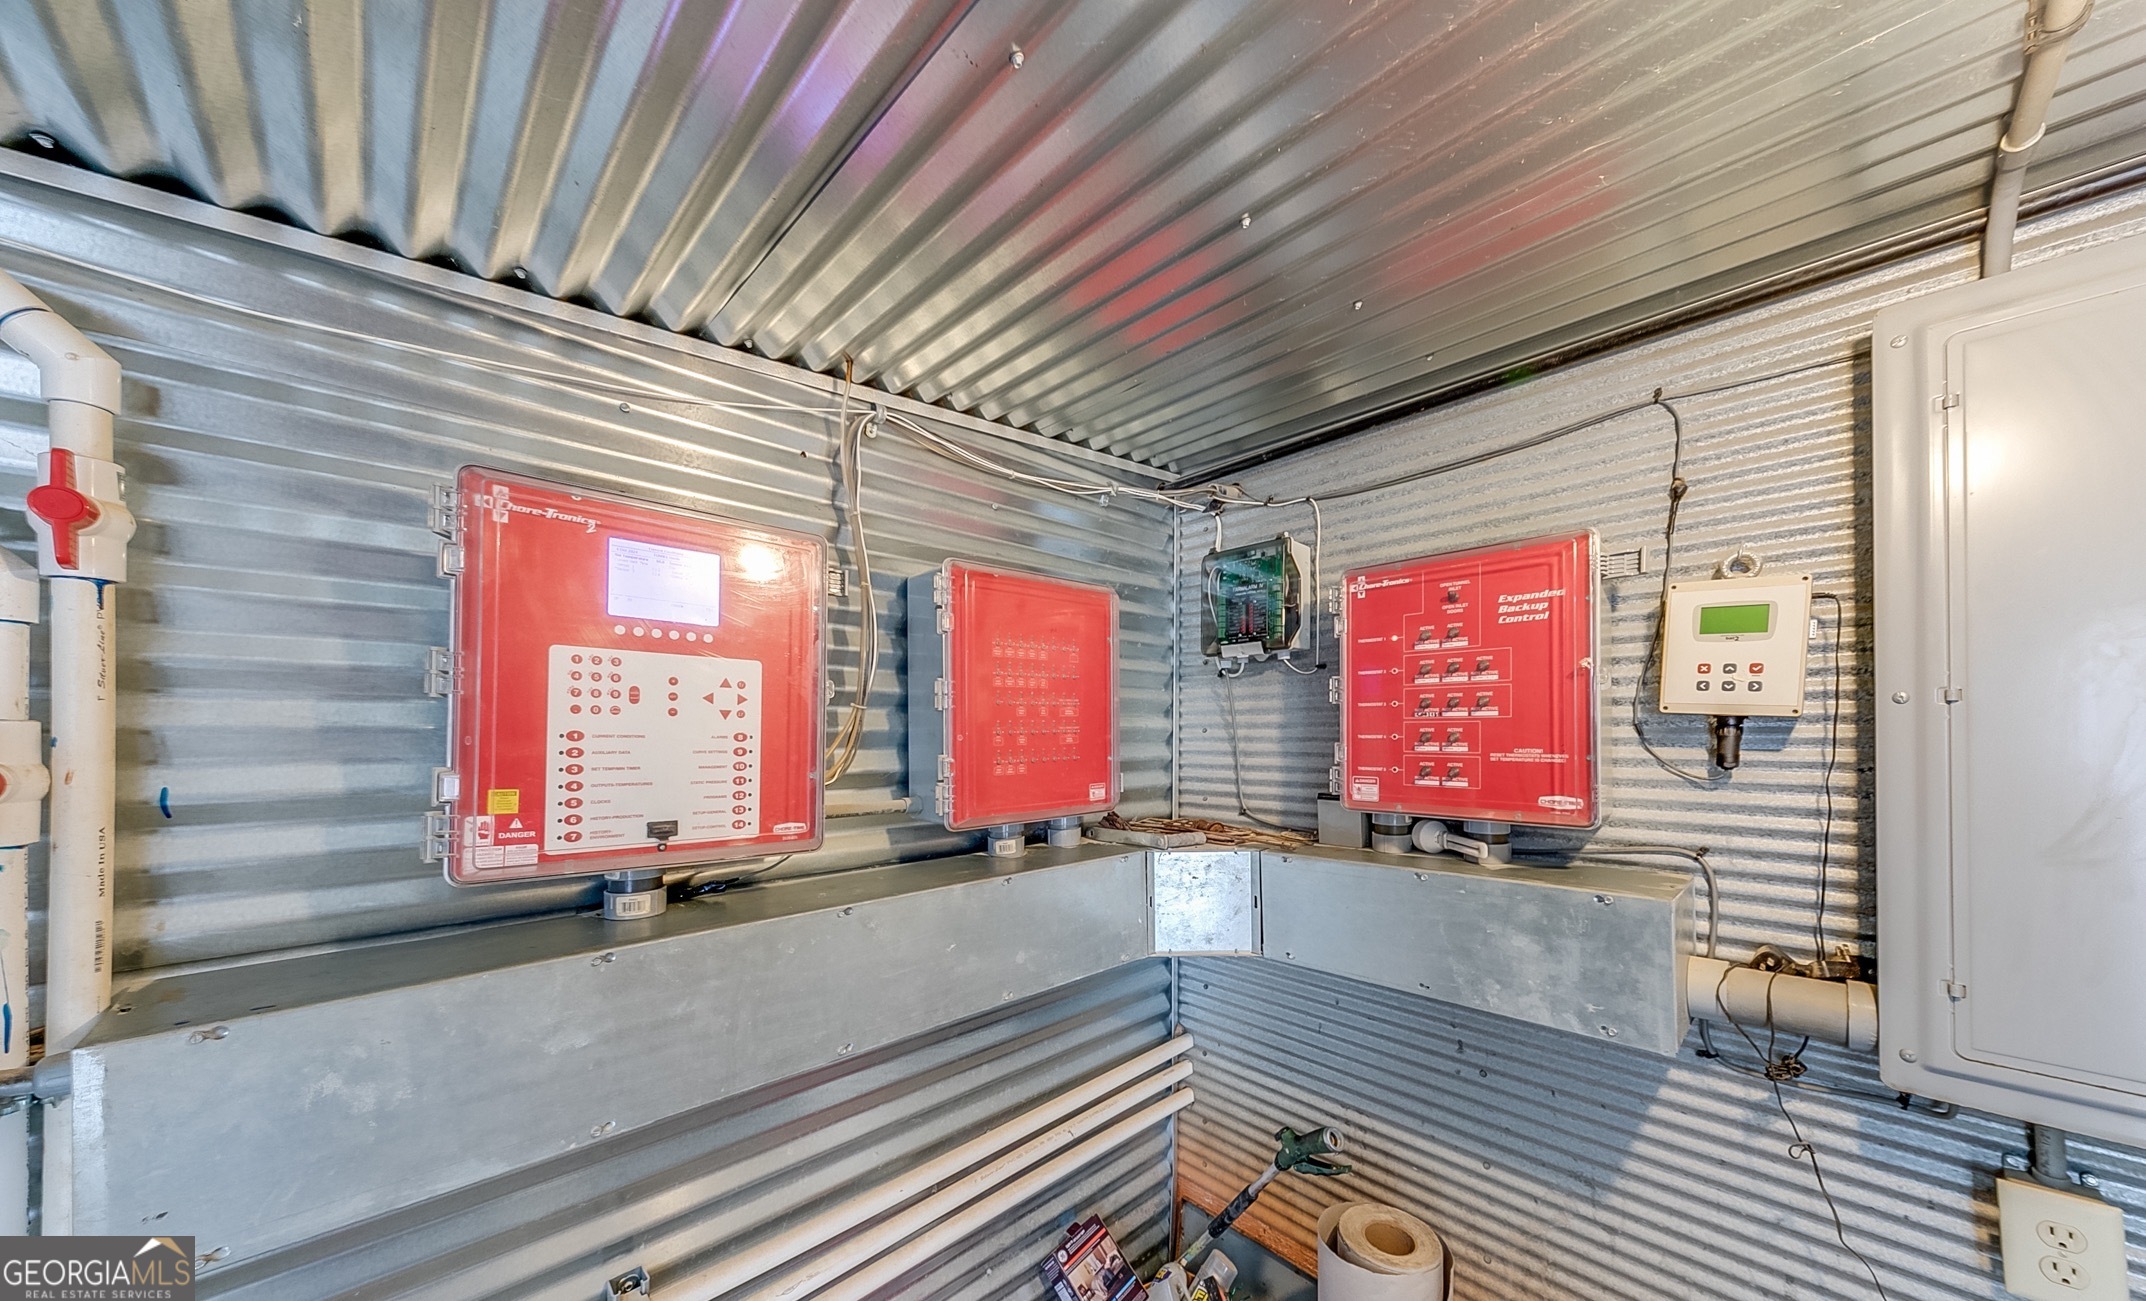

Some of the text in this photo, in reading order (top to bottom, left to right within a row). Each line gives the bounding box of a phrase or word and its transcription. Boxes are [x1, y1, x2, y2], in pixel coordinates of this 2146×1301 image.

[586, 523, 597, 534] 2
[1498, 588, 1566, 603] Expanded
[1498, 602, 1549, 613] Backup
[1498, 611, 1550, 624] Control
[97, 867, 105, 898] Made
